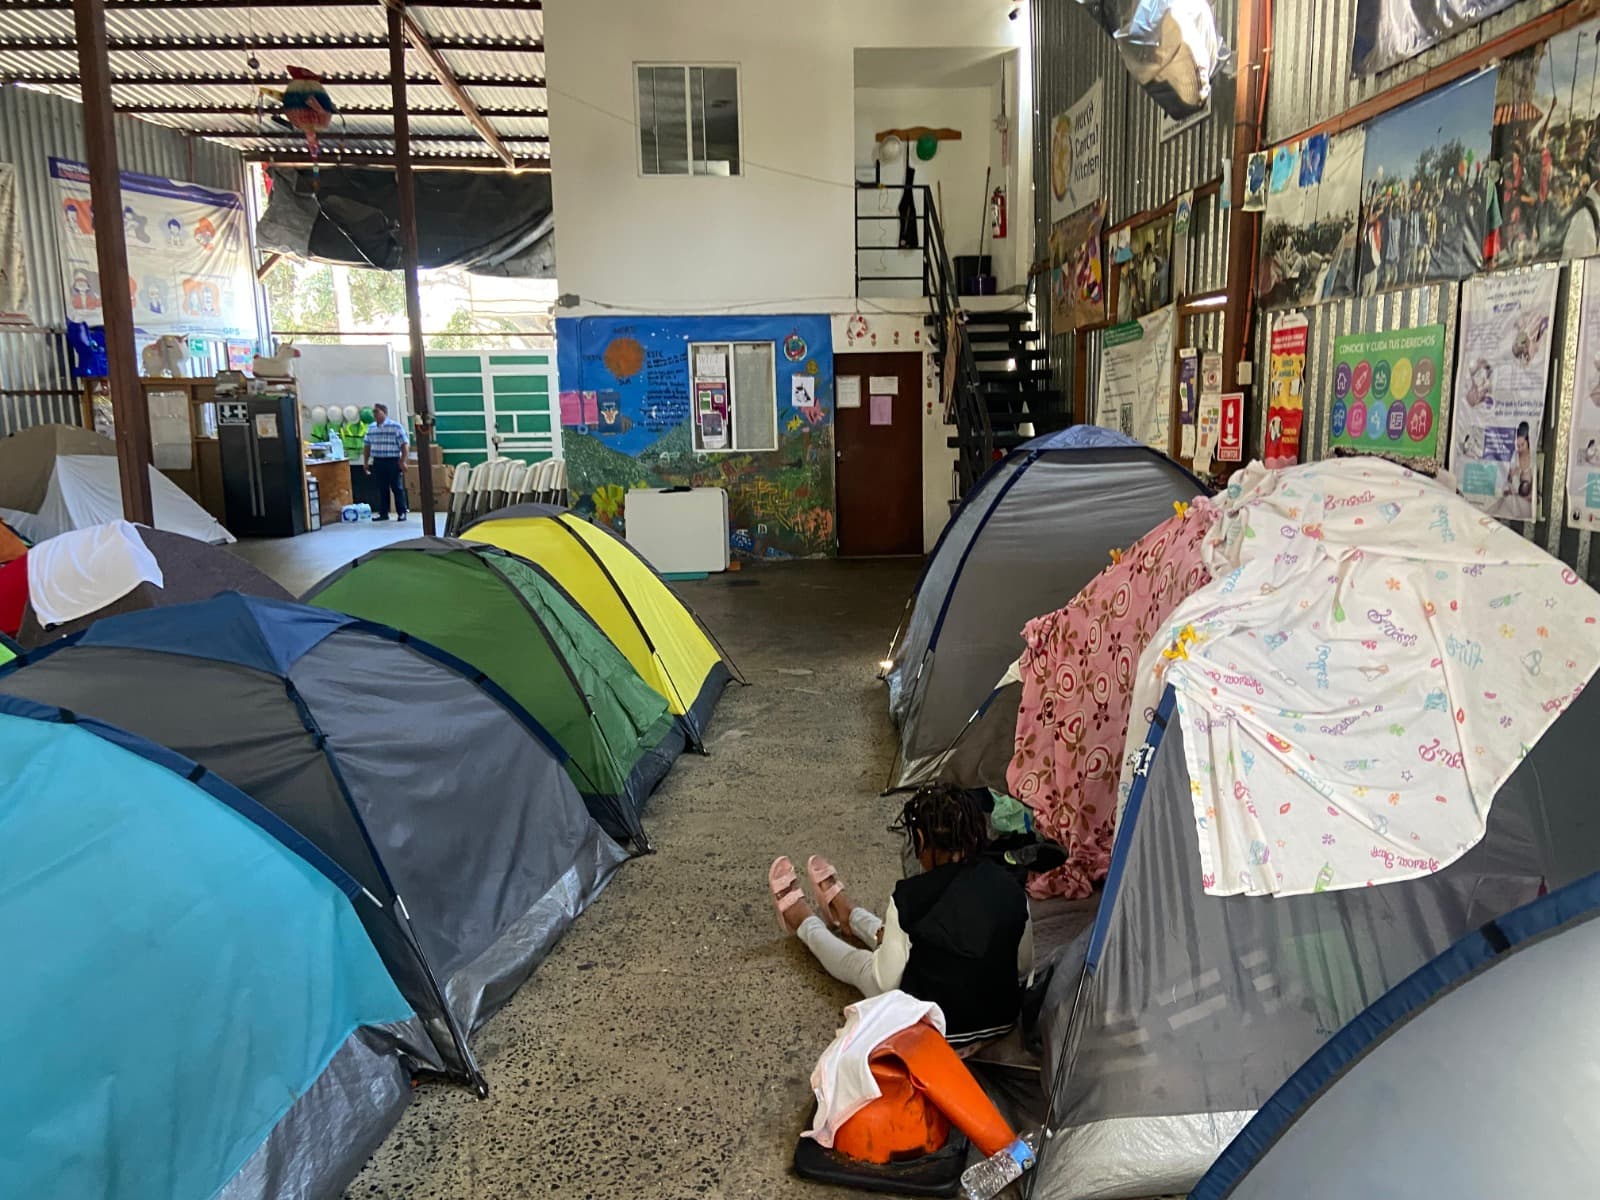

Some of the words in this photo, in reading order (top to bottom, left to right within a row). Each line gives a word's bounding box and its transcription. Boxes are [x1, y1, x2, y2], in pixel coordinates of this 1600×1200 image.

[1074, 123, 1099, 157] Central
[1074, 155, 1100, 182] Kitchen
[1365, 342, 1370, 352] Y
[1371, 340, 1387, 352] CUIDA
[1389, 338, 1400, 350] TUS
[1400, 335, 1436, 349] DERECHOS
